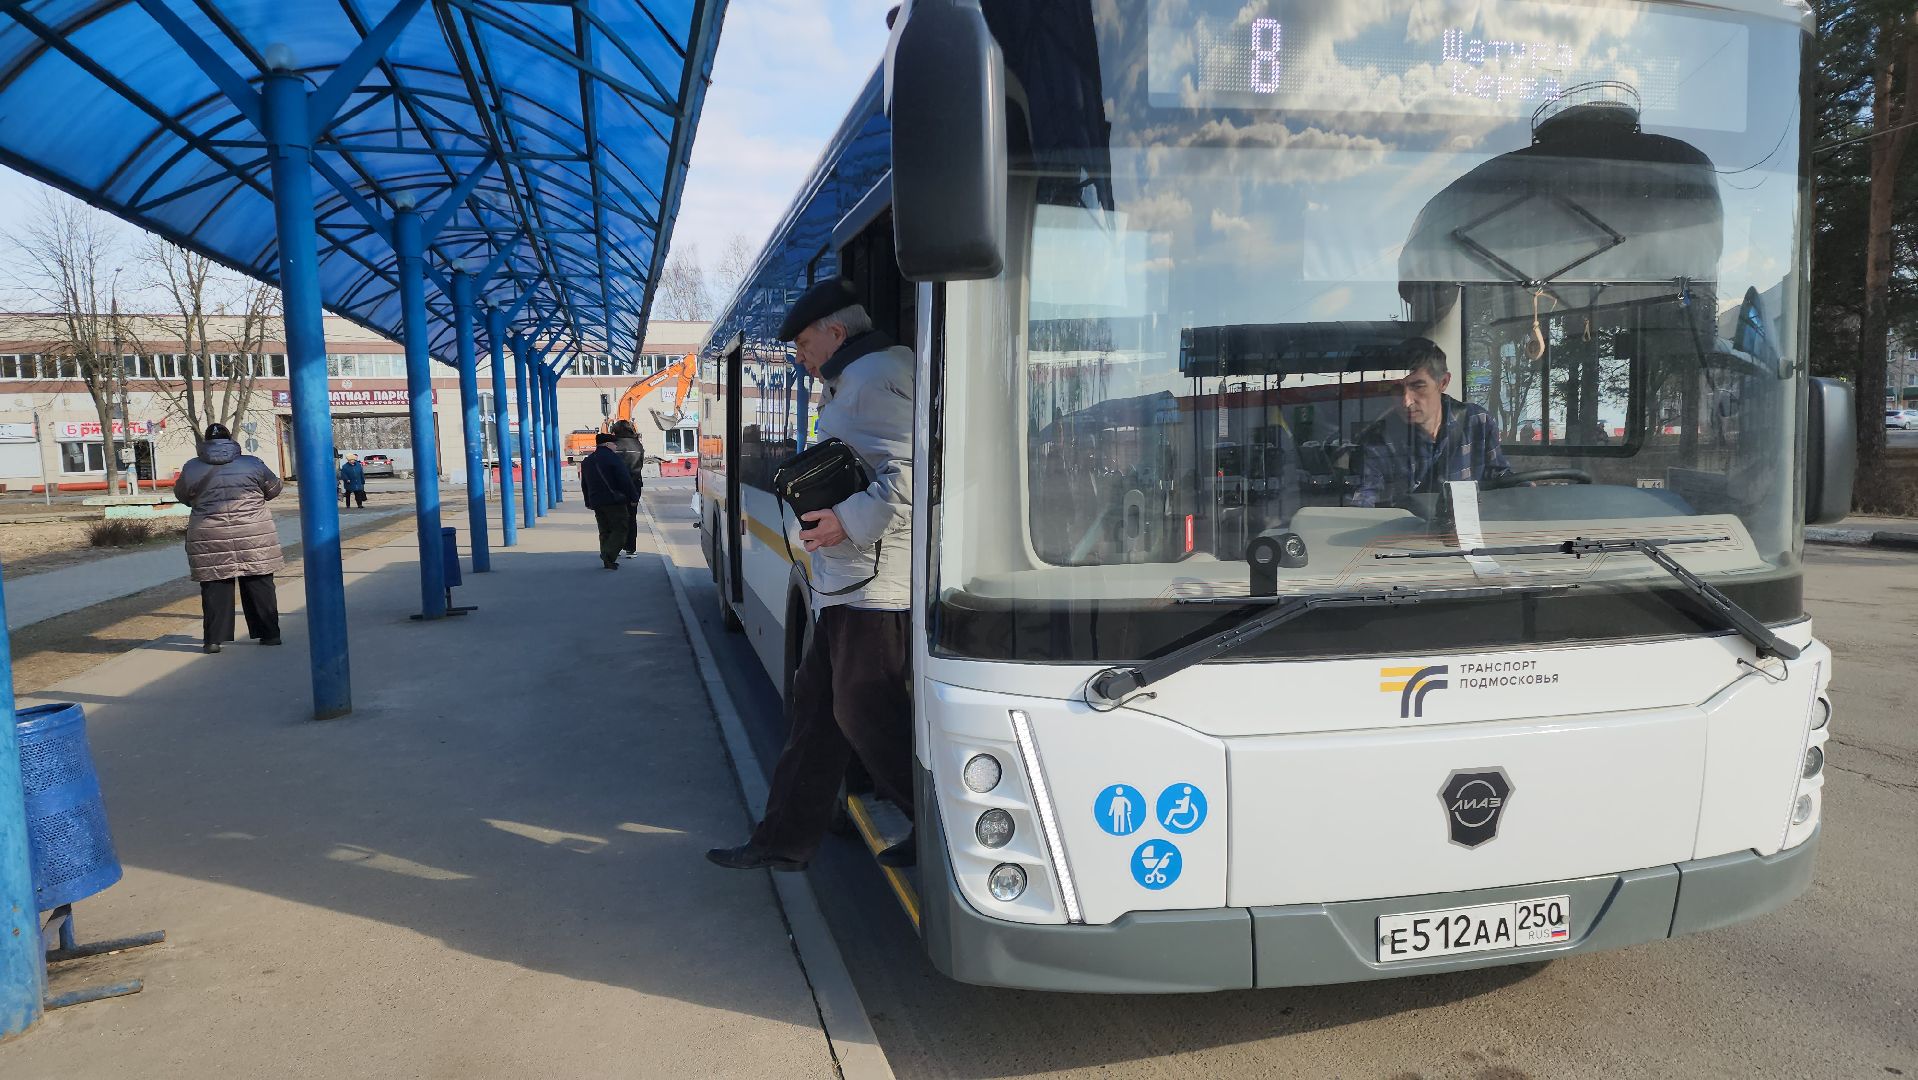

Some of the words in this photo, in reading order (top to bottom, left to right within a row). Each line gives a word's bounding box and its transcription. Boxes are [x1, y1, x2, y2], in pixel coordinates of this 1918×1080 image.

[1250, 18, 1282, 94] 8
[1442, 28, 1574, 69] Шатура
[1452, 65, 1561, 102] Керва
[328, 391, 371, 401] АТНАЯ
[67, 424, 146, 437] Бритоль
[1460, 660, 1537, 674] ТРАНСПОРТ
[1459, 673, 1559, 689] ПОДМОСКОВЬЯ
[1390, 915, 1511, 955] Е512АА
[1518, 902, 1564, 931] 250
[1528, 928, 1550, 940] RUS
